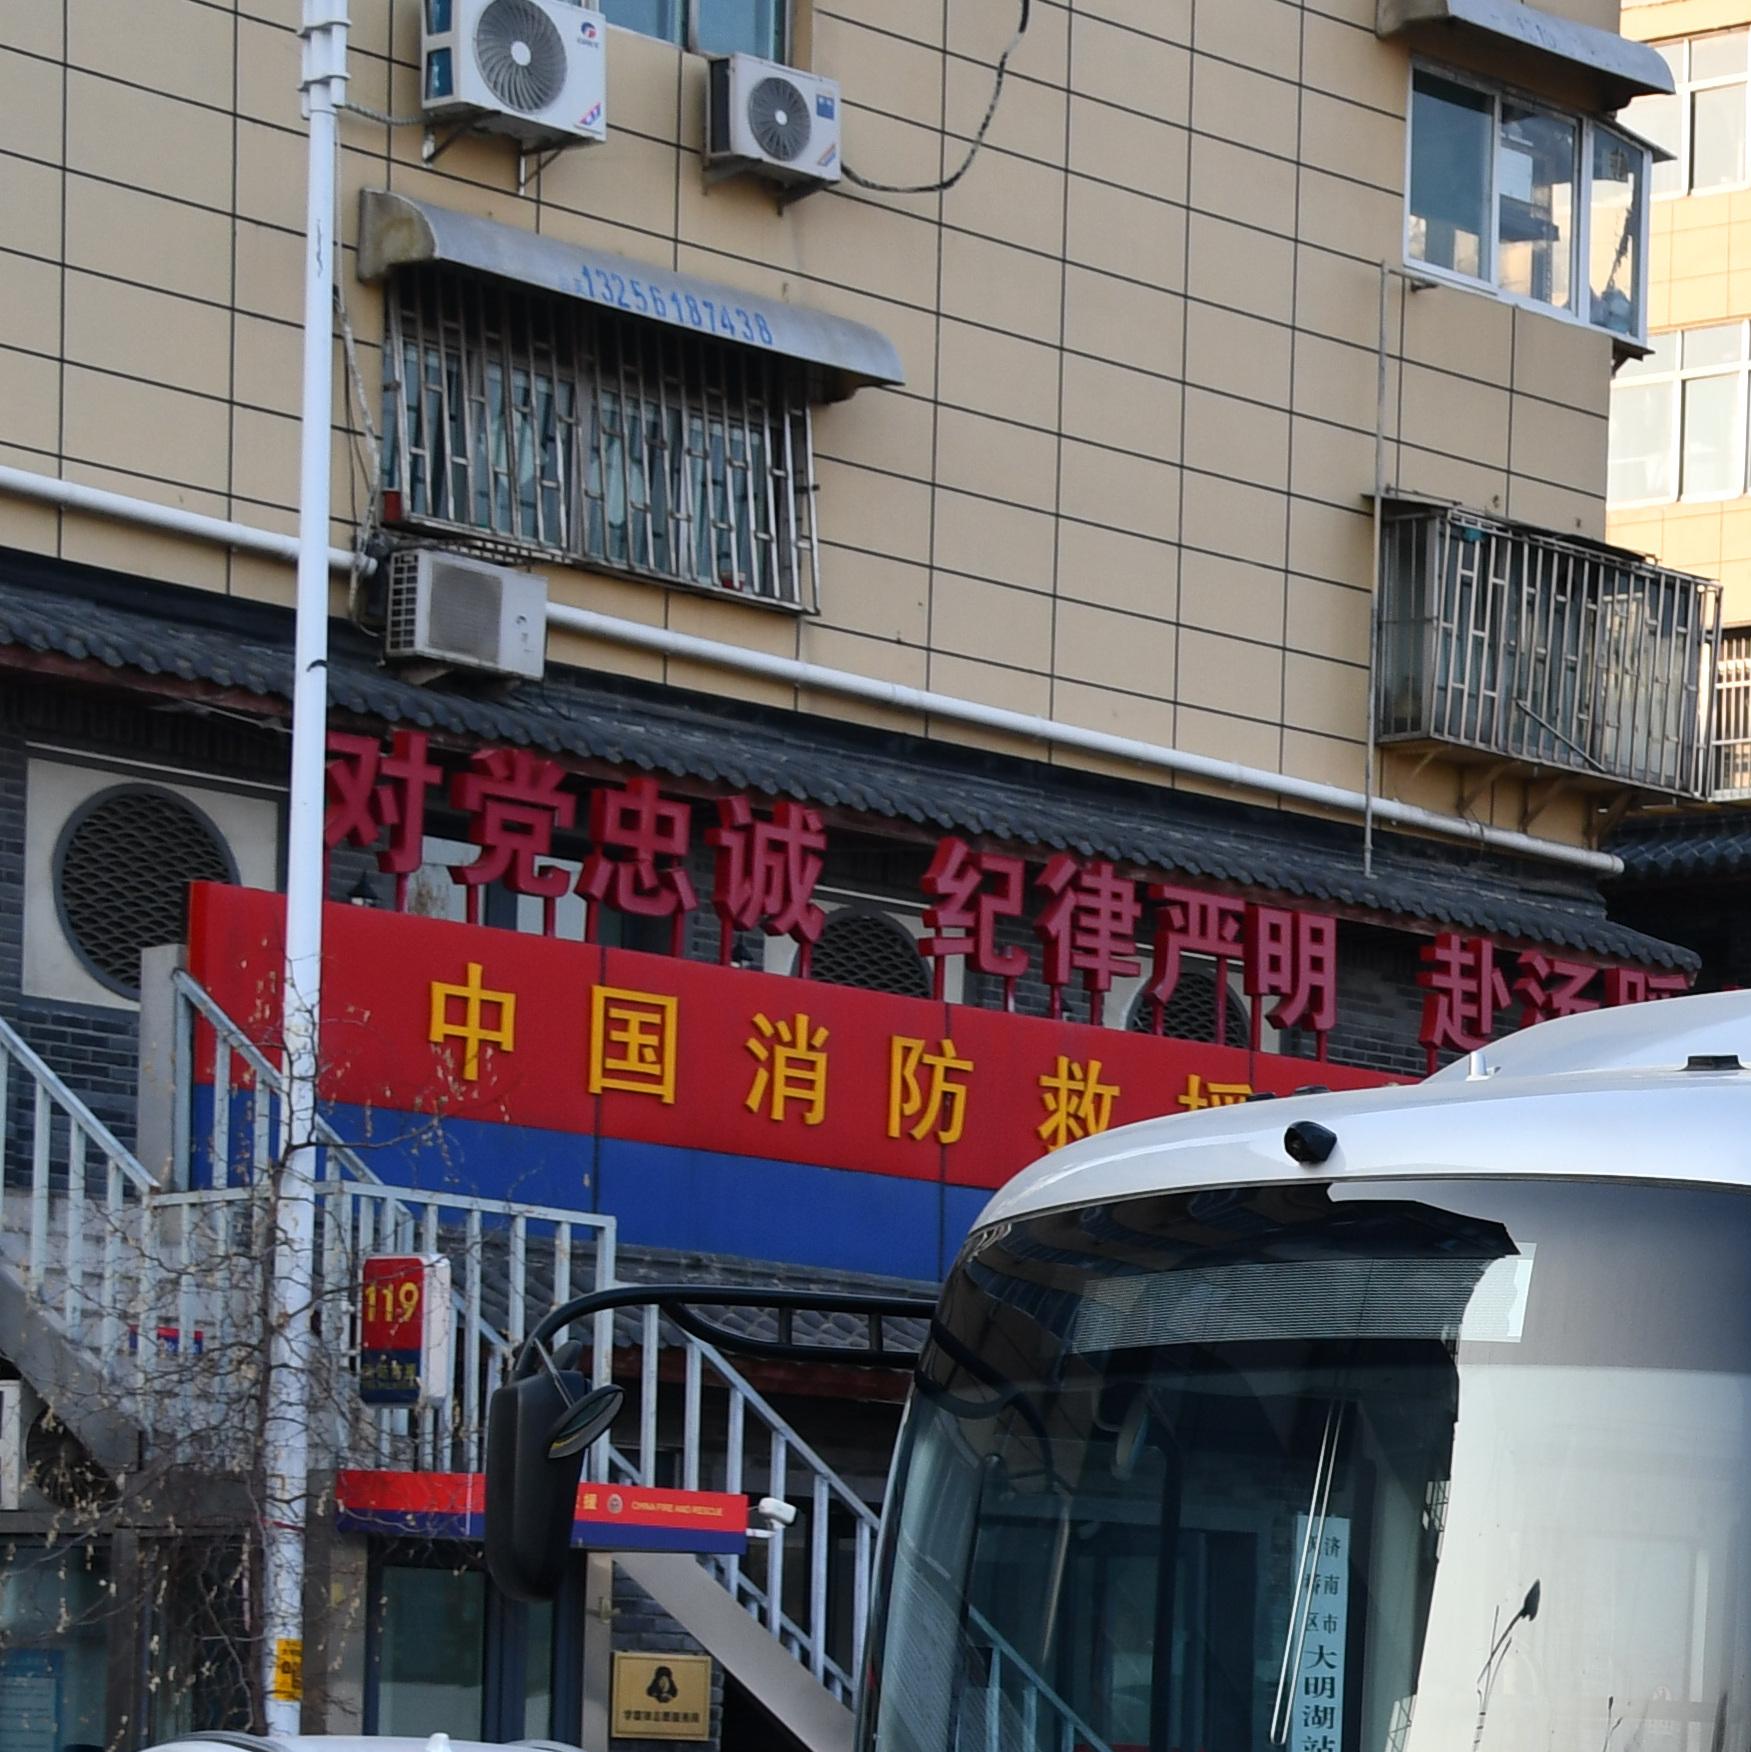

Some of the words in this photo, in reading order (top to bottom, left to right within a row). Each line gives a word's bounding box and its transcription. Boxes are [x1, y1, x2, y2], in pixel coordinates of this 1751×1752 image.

[582, 265, 773, 345] 13256187438
[325, 730, 826, 943] 对党忠诚
[919, 837, 1337, 1031] 纪律严明
[365, 1282, 419, 1322] 119
[1323, 1536, 1342, 1634] 济南市
